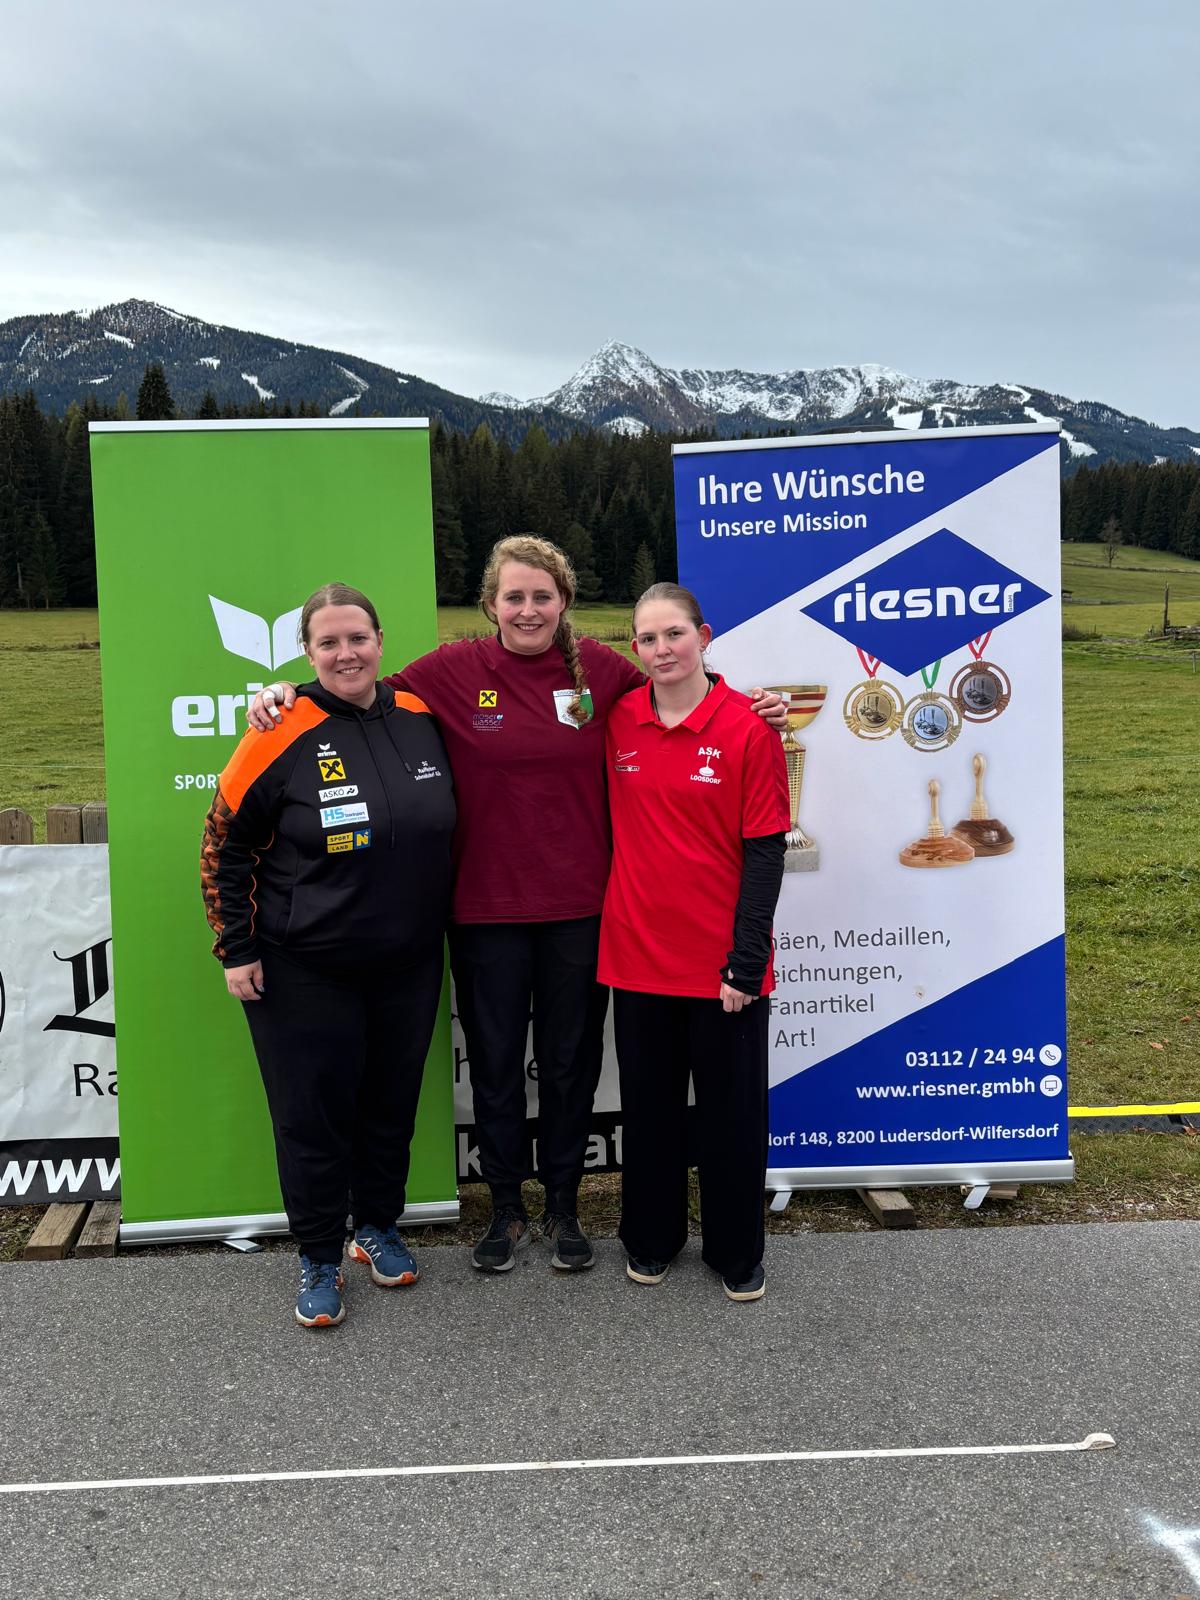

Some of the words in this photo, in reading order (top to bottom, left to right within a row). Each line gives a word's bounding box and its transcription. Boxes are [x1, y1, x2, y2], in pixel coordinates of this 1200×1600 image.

[699, 474, 762, 505] Ihre
[772, 464, 925, 500] Wünsche
[700, 519, 776, 538] Unsere
[783, 511, 867, 532] Mission
[834, 583, 1022, 623] riesner
[698, 746, 722, 759] ASK
[174, 773, 221, 790] SPOR
[690, 774, 721, 785] LOOSDORF
[323, 807, 344, 821] HS
[330, 834, 350, 843] SPORT
[331, 844, 349, 852] LAND
[834, 926, 951, 948] Medaillen,
[769, 993, 874, 1016] Fanartikel
[774, 1027, 816, 1048] Art!
[905, 1050, 963, 1067] 03112
[968, 1047, 978, 1068] /
[983, 1048, 1007, 1064] 24
[1012, 1047, 1036, 1063] 94
[856, 1077, 1036, 1099] www.riesner.gmbh
[800, 1130, 832, 1147] 148,
[837, 1129, 875, 1144] 8200
[879, 1123, 1059, 1143] Ludersdorf-Wilfersdorf
